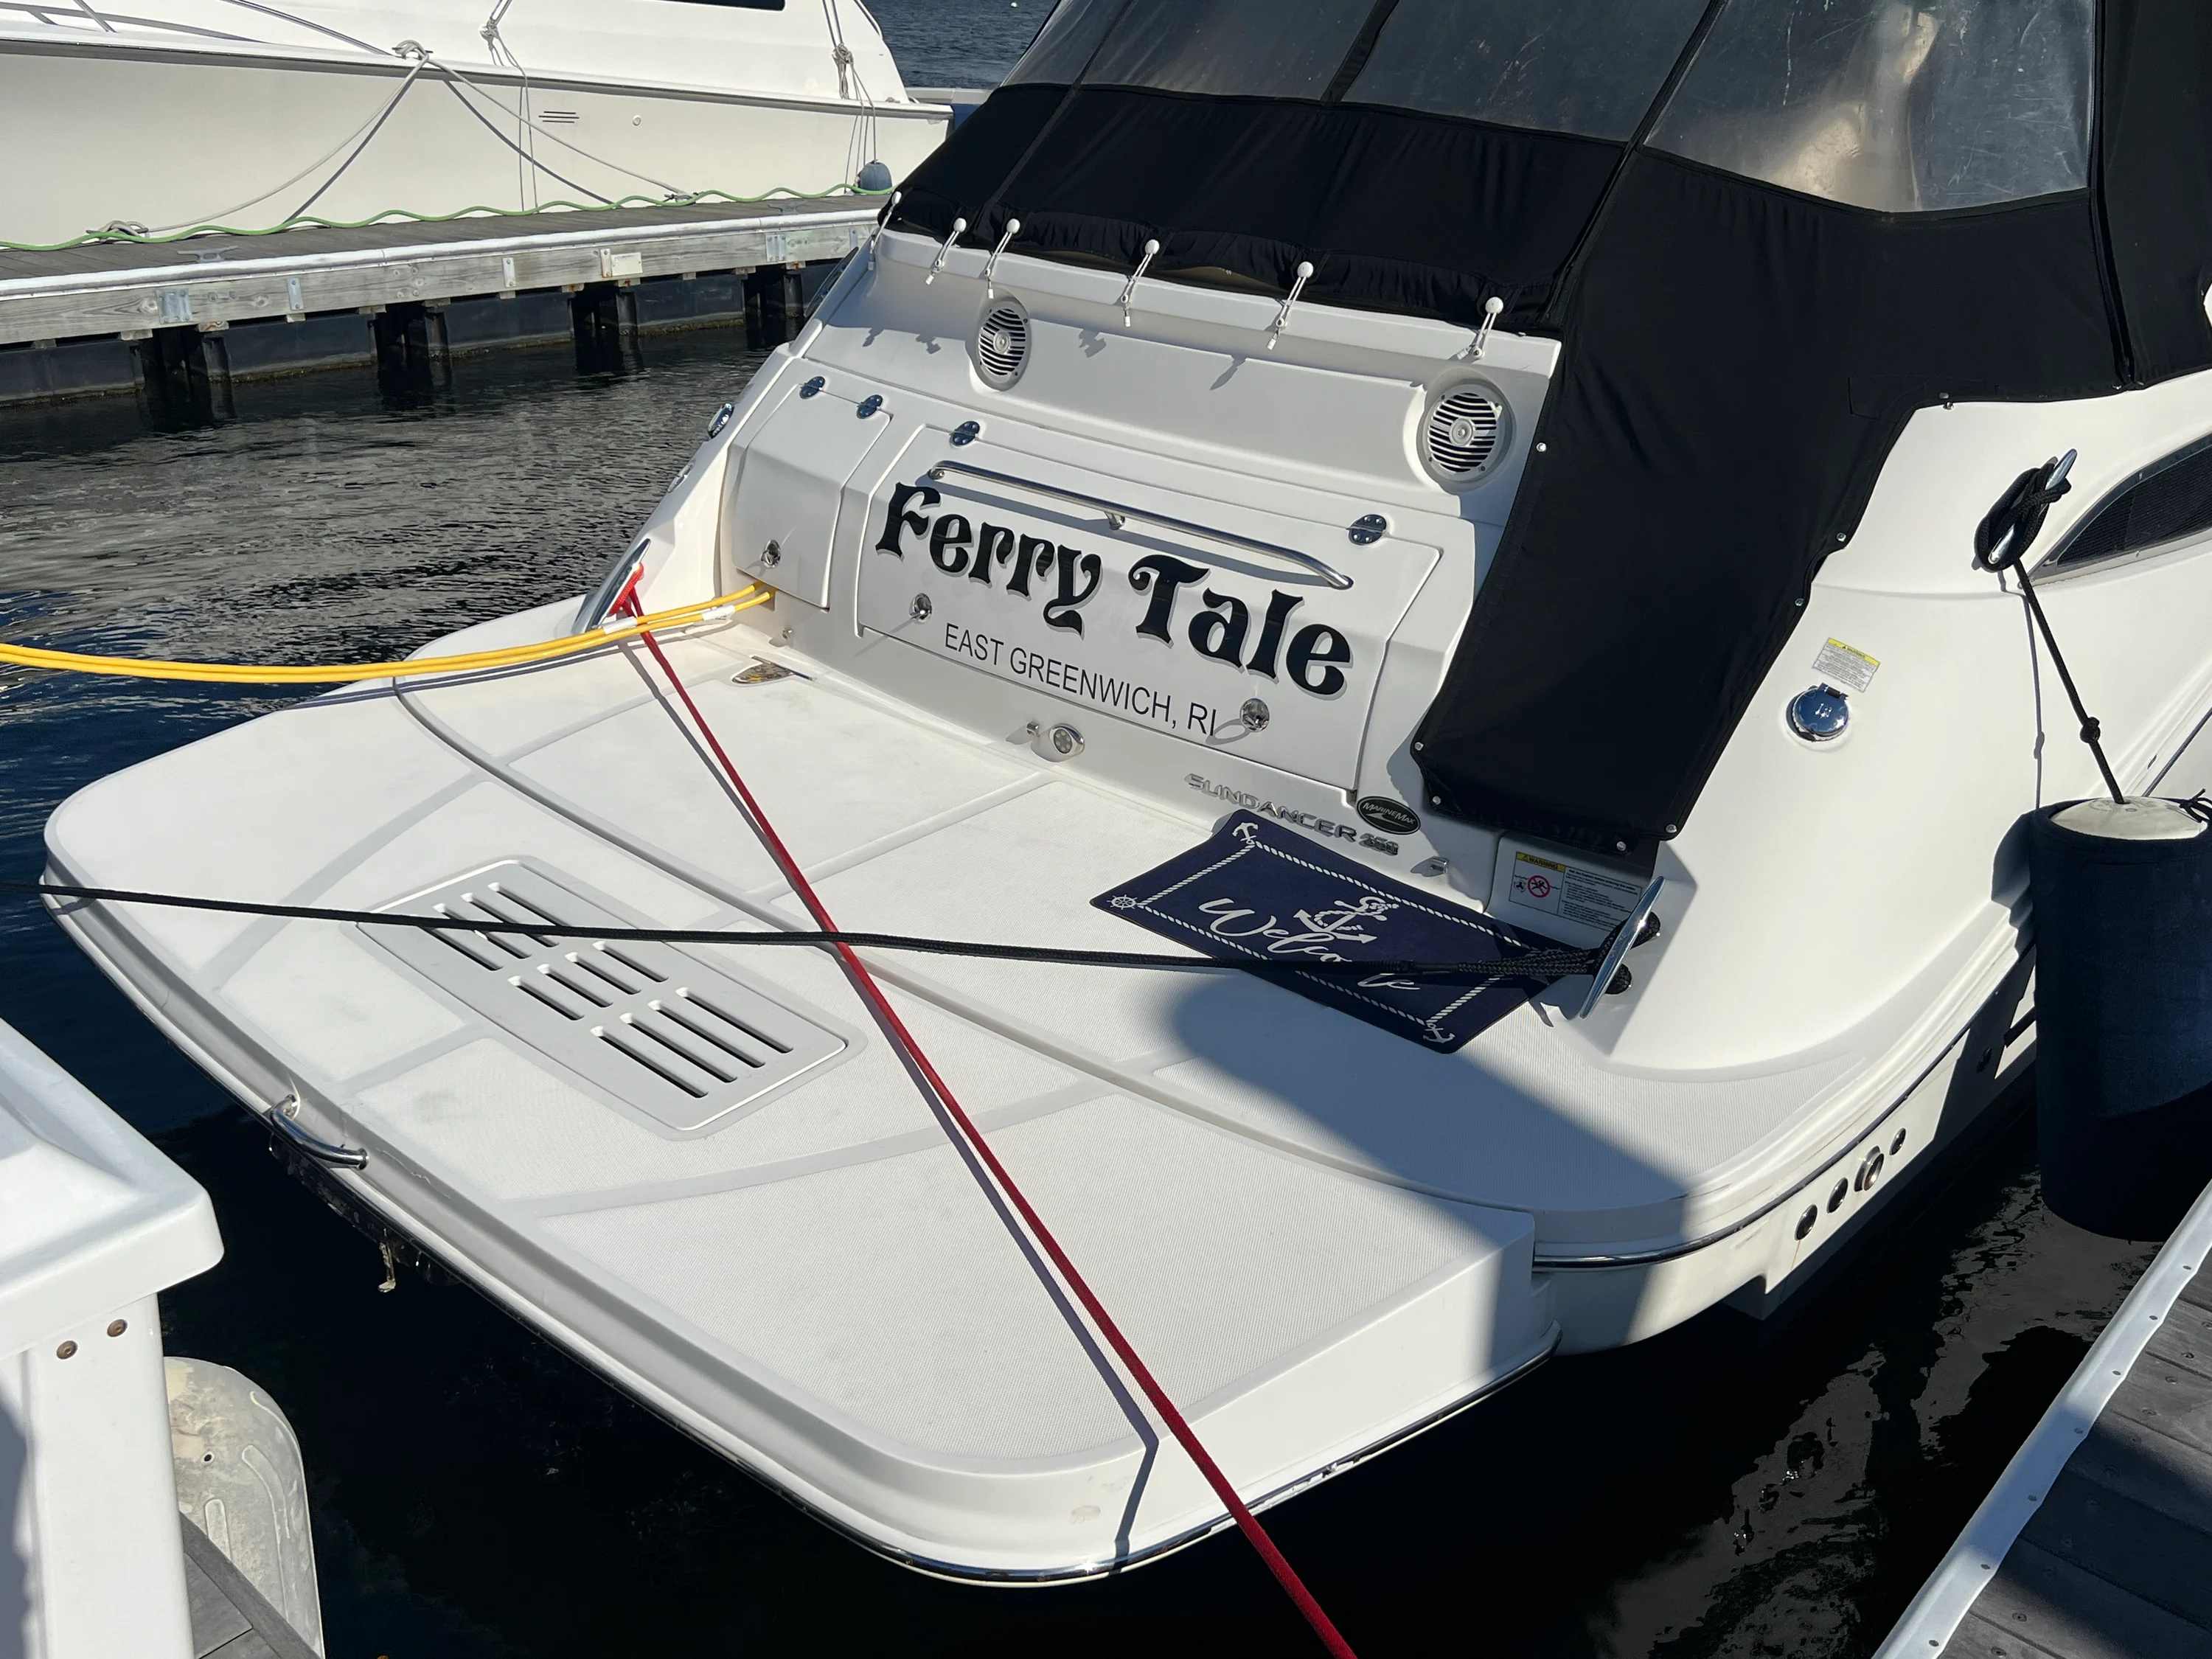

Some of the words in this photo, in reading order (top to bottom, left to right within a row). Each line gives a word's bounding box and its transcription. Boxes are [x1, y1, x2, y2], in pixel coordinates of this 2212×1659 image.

[875, 481, 1102, 636] Ferry
[1128, 554, 1352, 695] Tale
[944, 625, 1005, 666] EAST
[1010, 647, 1177, 729] GREENWICH,
[1188, 701, 1217, 737] RI
[1184, 773, 1357, 843] SUNDANCER
[1528, 856, 1558, 870] WARNING
